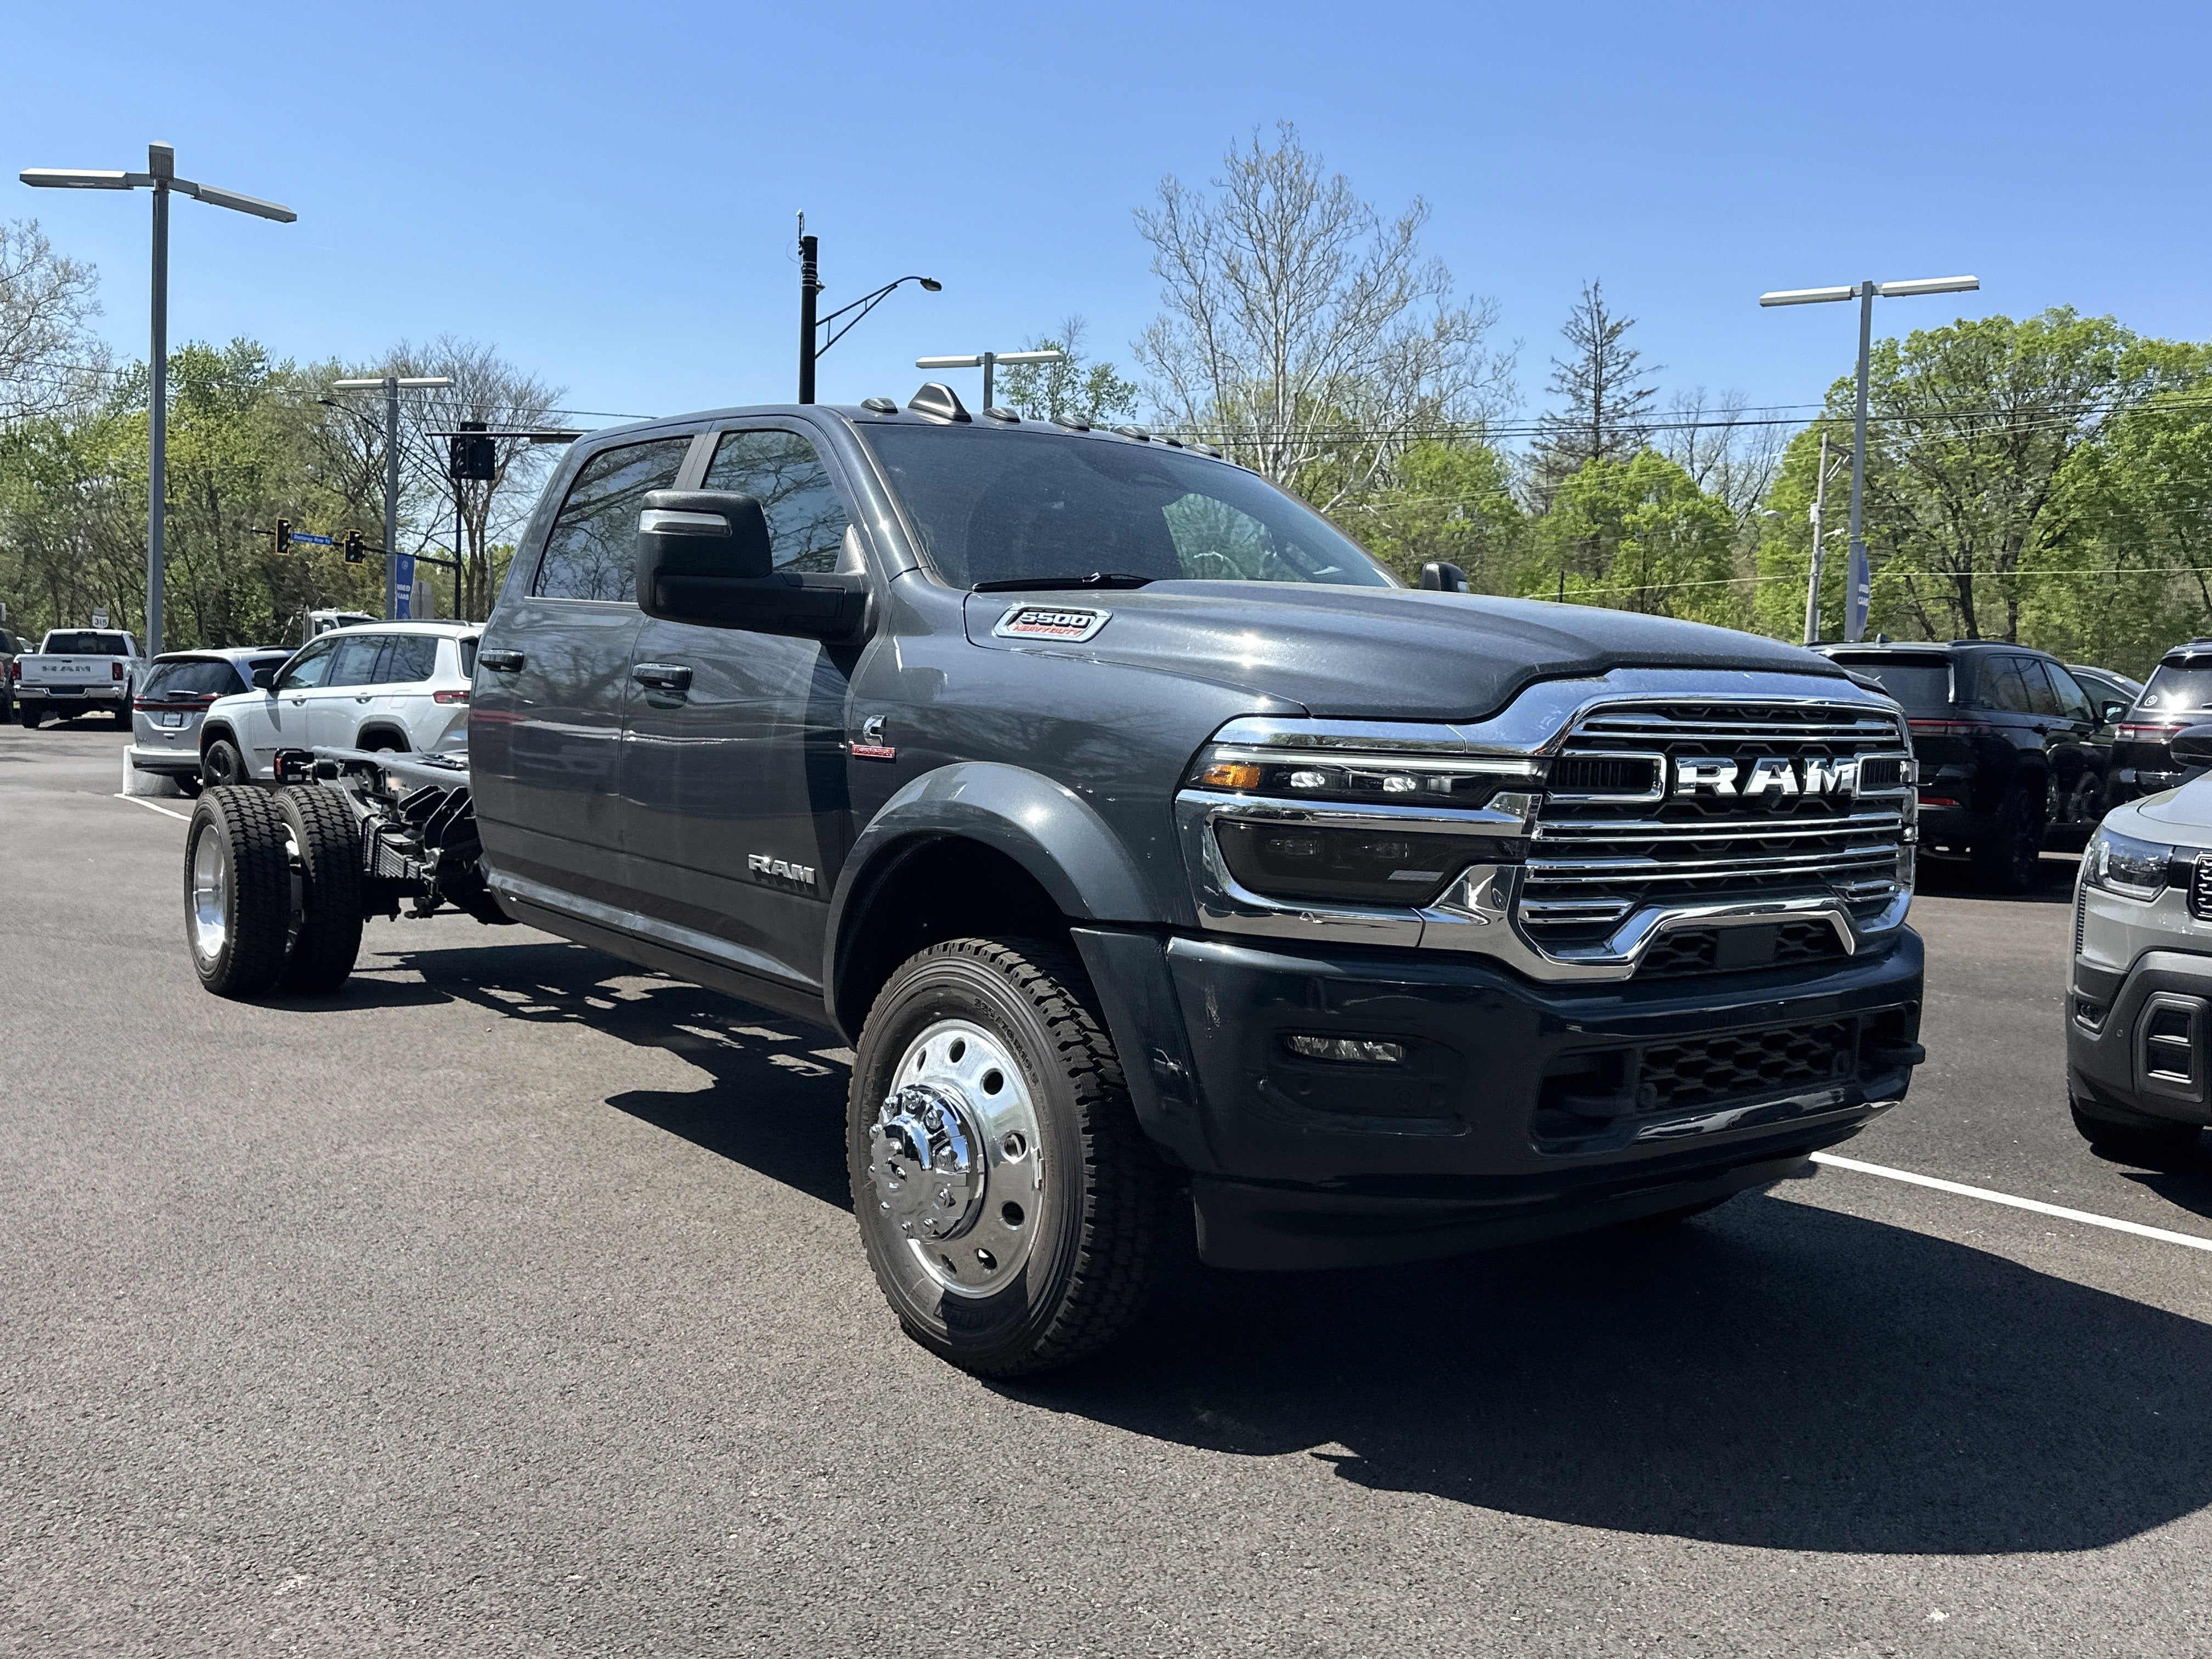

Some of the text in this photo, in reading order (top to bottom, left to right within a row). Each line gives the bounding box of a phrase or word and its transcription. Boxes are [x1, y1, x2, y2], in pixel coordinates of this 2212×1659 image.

[1020, 612, 1090, 628] 5500
[1674, 757, 1858, 796] RAM
[748, 854, 815, 884] RAM
